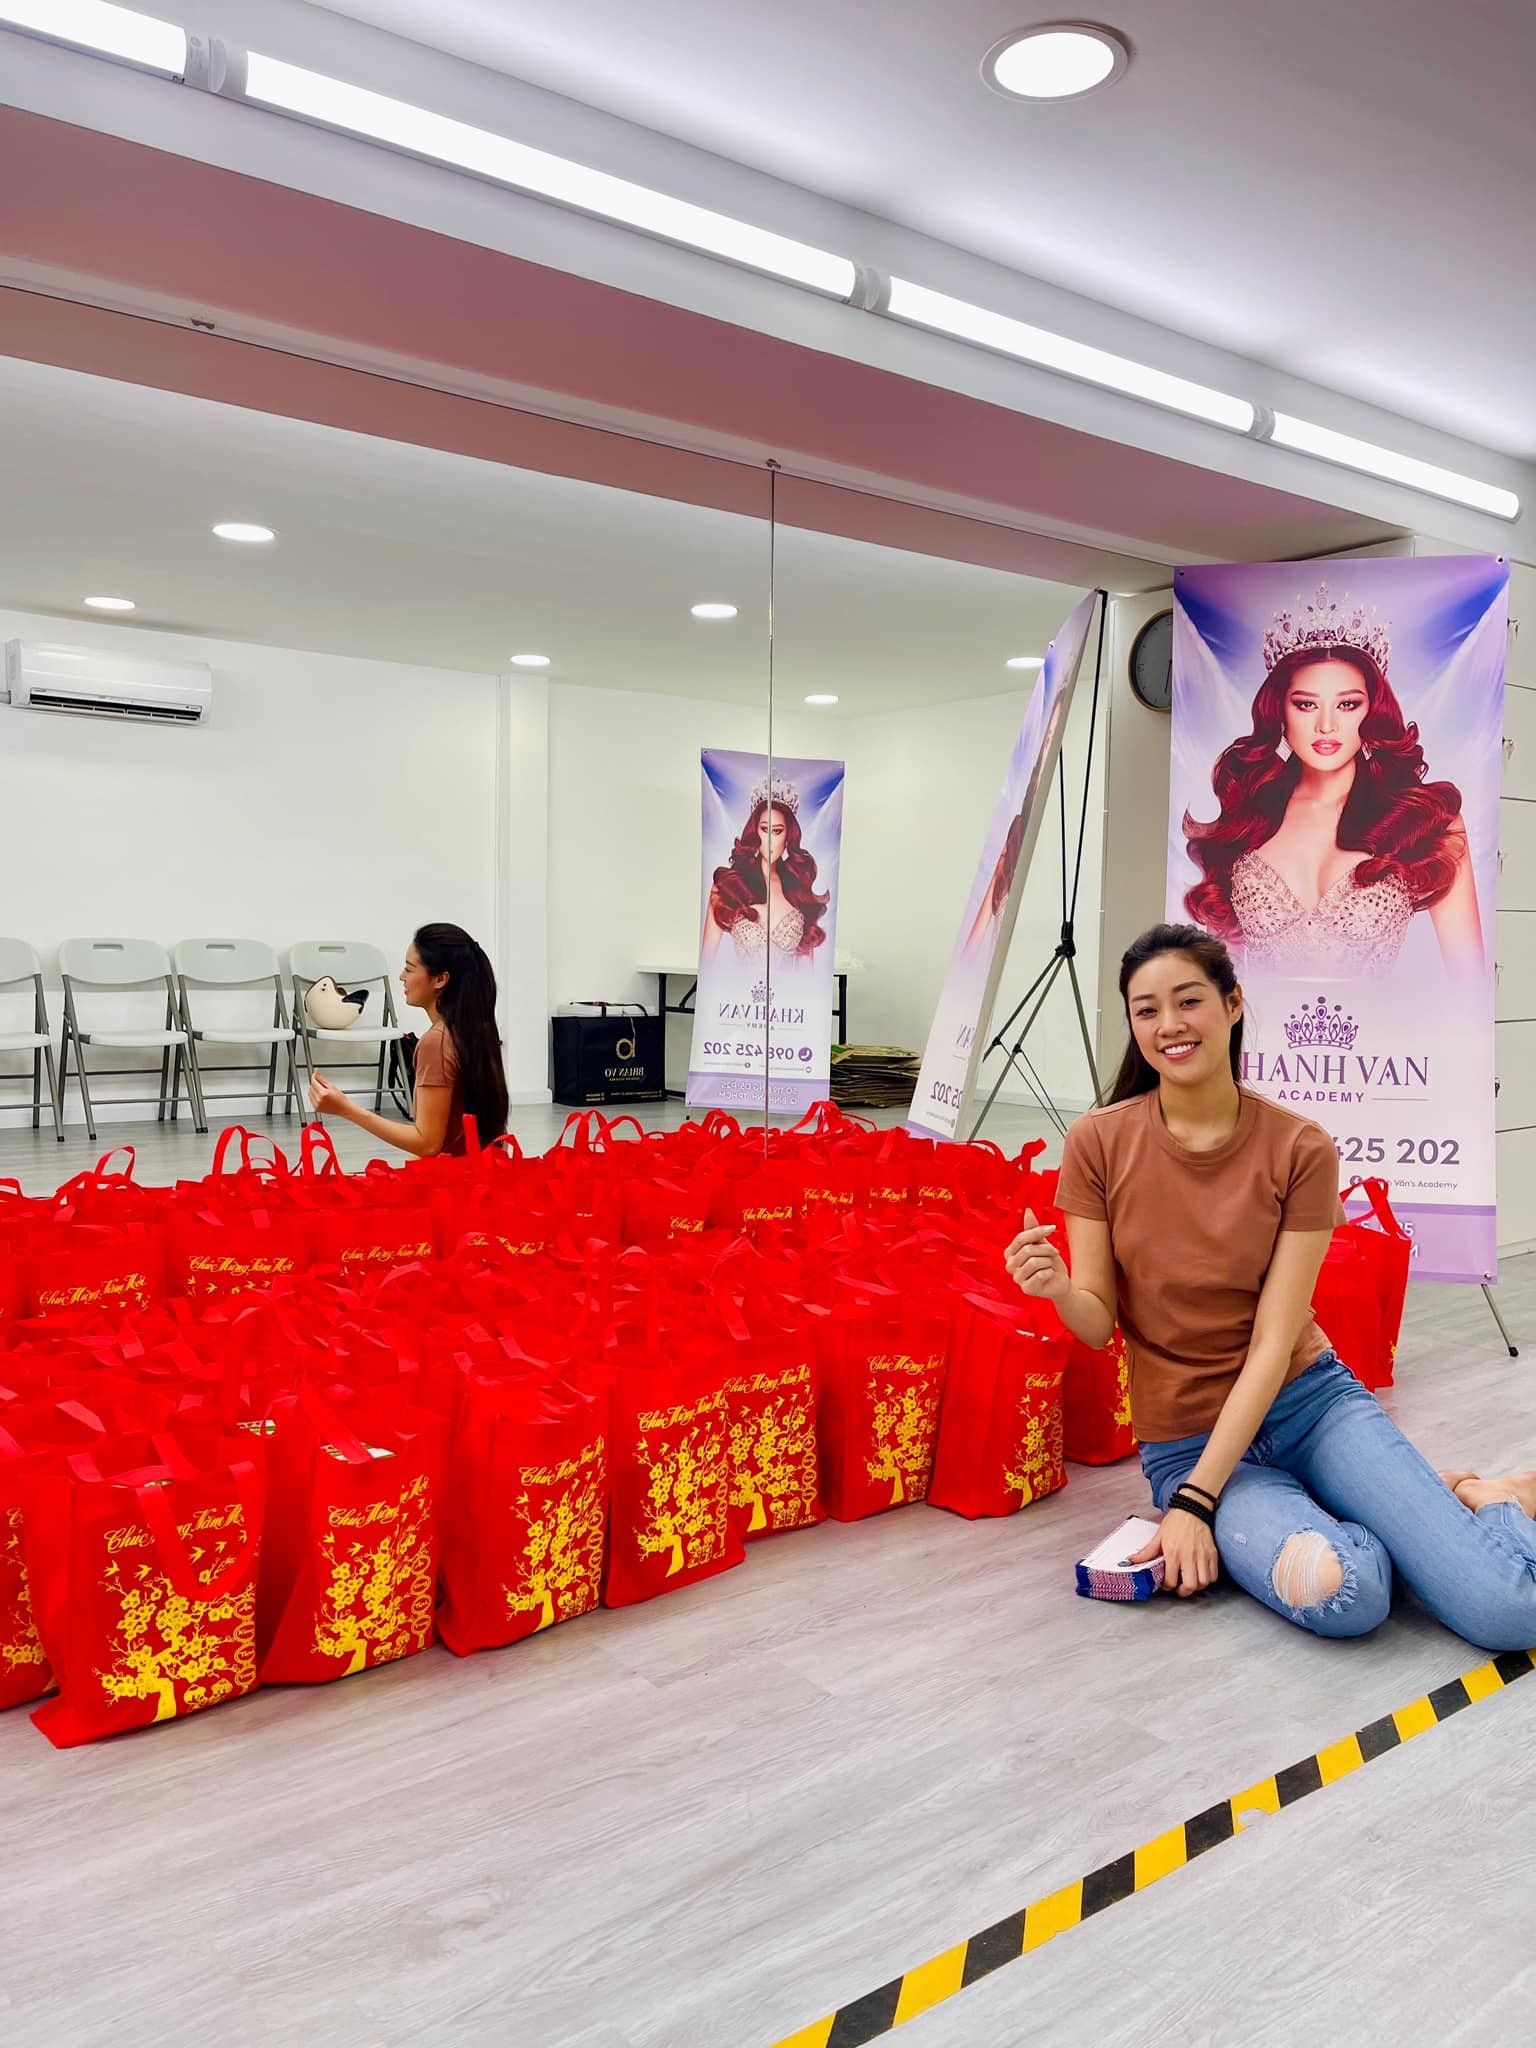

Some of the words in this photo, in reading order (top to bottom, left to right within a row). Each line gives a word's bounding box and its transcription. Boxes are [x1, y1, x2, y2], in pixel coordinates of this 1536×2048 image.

[1241, 1052, 1347, 1085] HANH
[1356, 1056, 1429, 1086] VAN
[1278, 1089, 1365, 1103] ACADEMY
[1396, 1138, 1460, 1165] 202
[1417, 1180, 1458, 1190] Academy
[518, 1466, 559, 1487] Chúc
[328, 1505, 366, 1529] Chúc
[103, 1525, 155, 1553] Chúc
